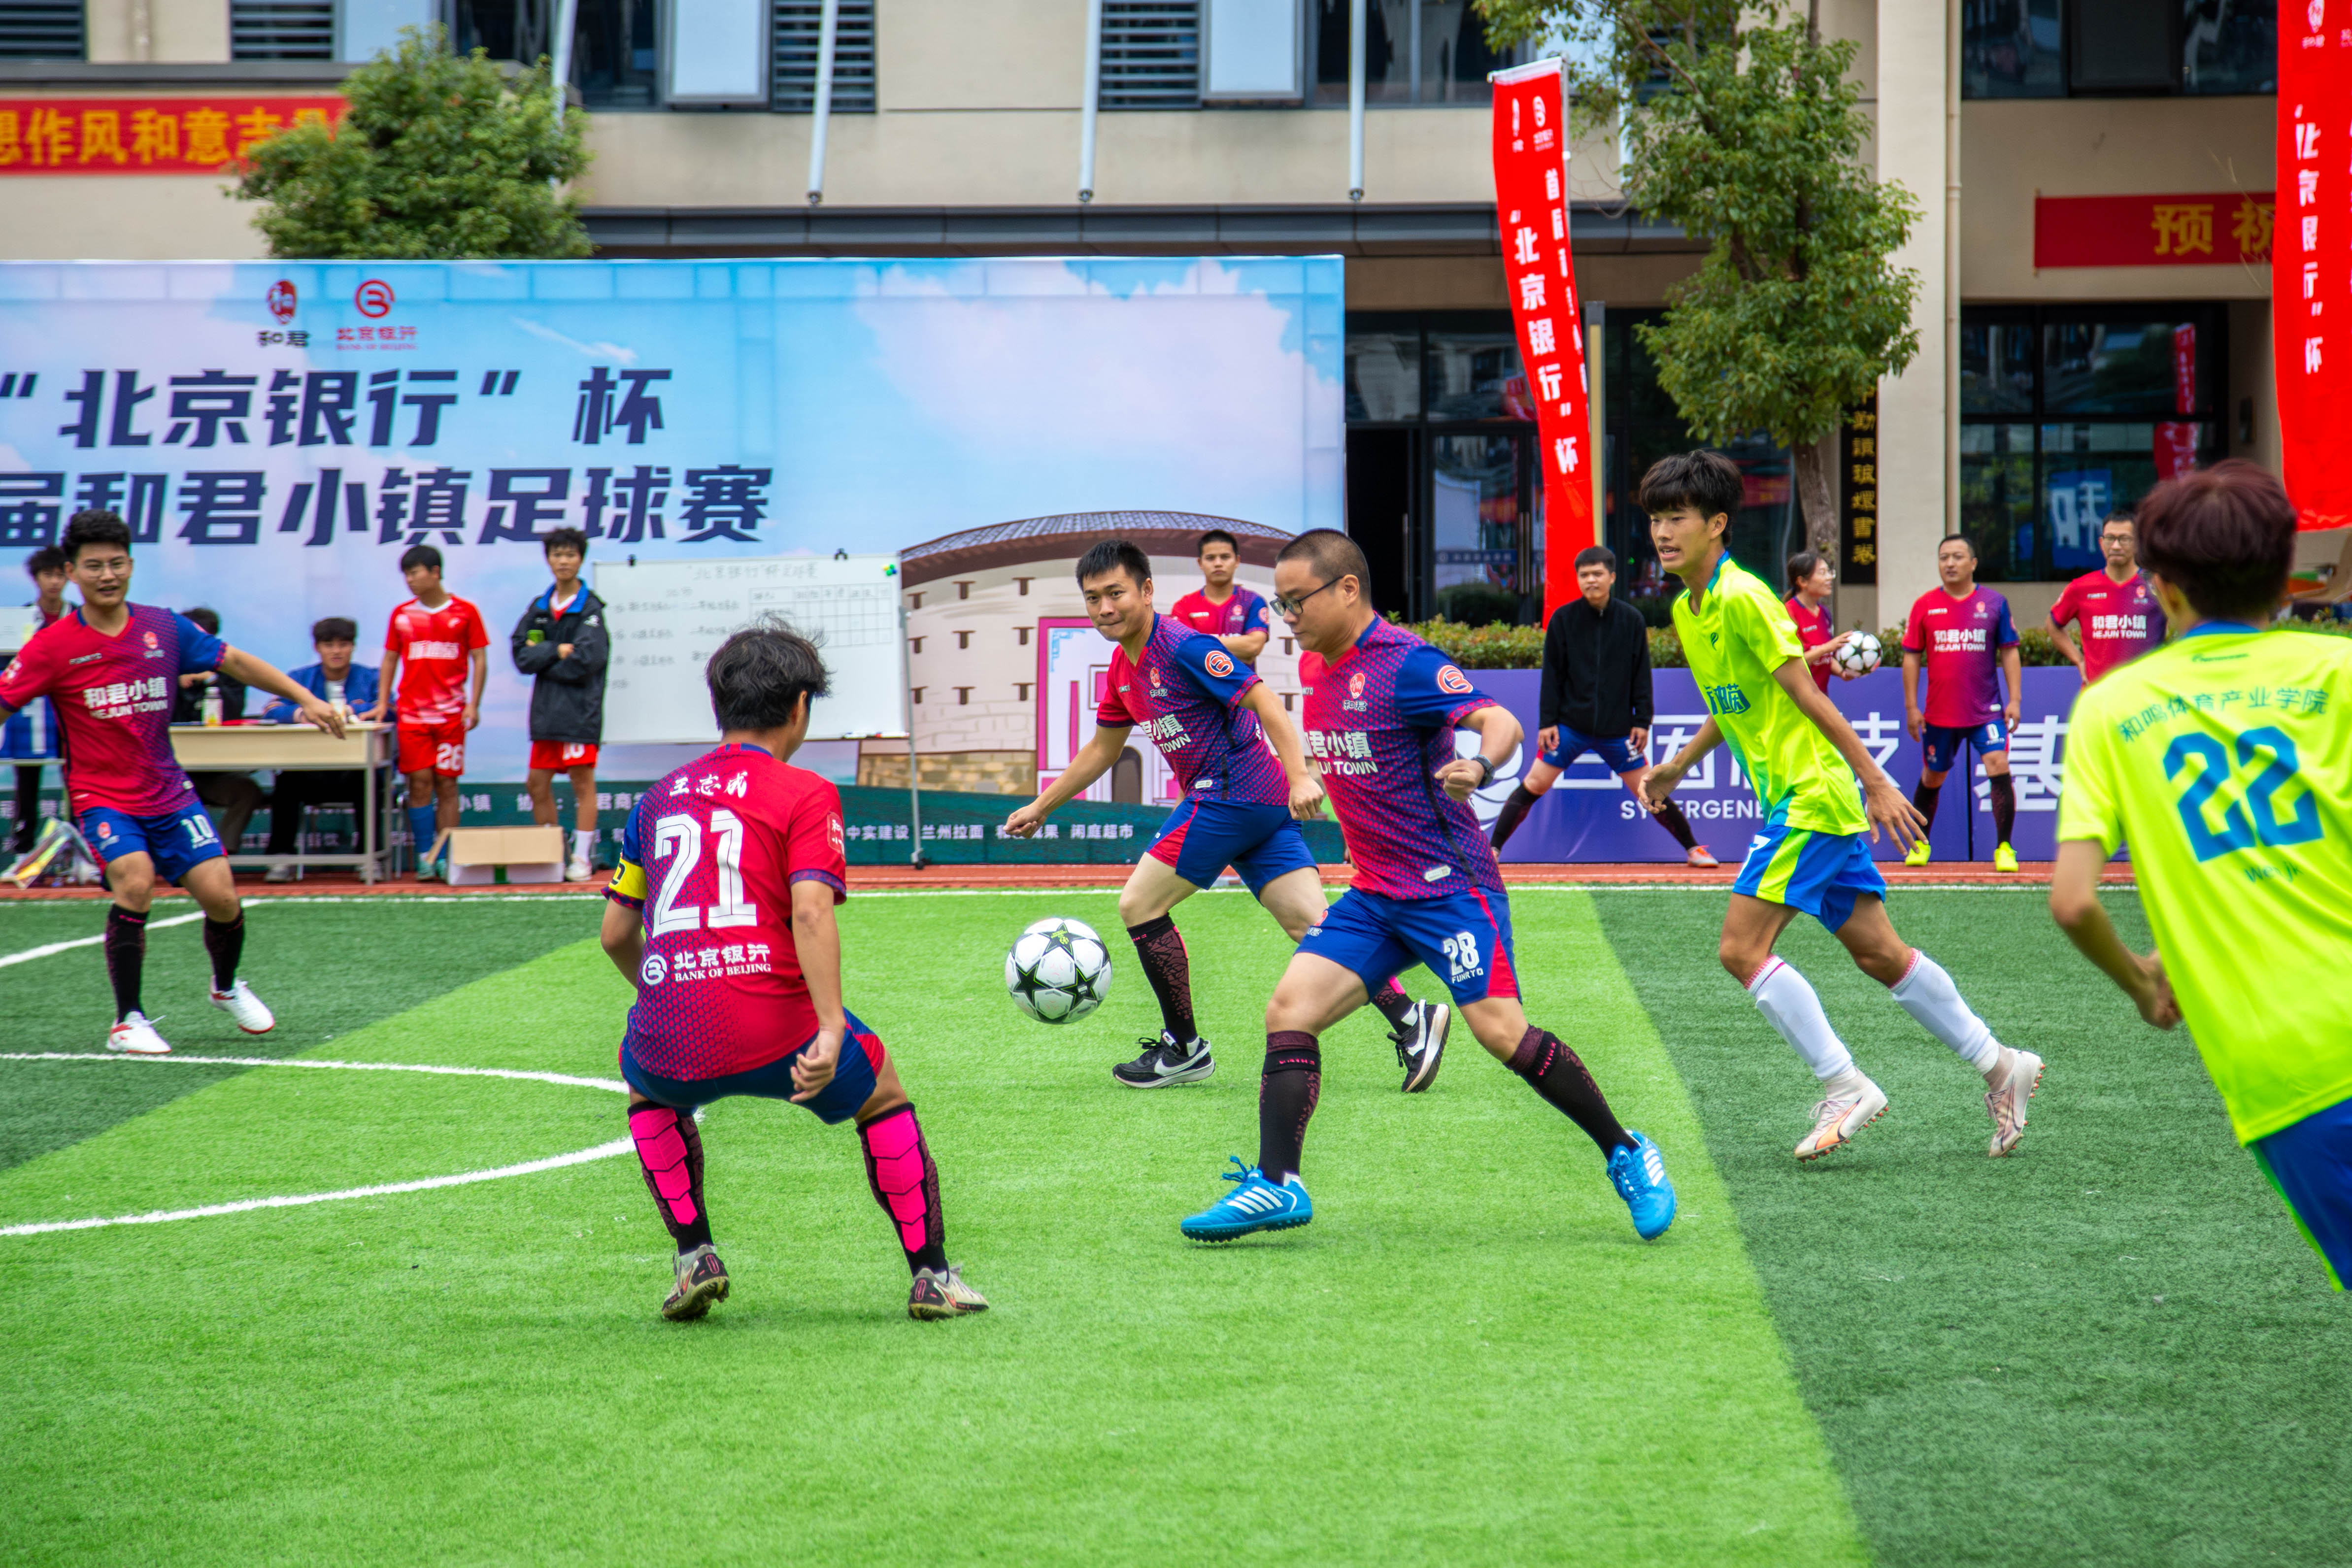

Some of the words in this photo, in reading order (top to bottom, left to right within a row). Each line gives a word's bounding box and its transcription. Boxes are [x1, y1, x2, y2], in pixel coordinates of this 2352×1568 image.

[2092, 614, 2147, 630] 和君小镇
[1934, 629, 1986, 644] 和君小镇
[2120, 630, 2147, 639] TOWN
[1962, 643, 1986, 652] TOWN
[83, 676, 168, 709] 和君小镇
[1344, 700, 1368, 711] 和君
[2118, 687, 2329, 742] 和鸣体育产业学院
[1305, 731, 1373, 760] 君小镇
[1334, 761, 1378, 775] TOWN
[2163, 726, 2324, 862] 22
[180, 814, 215, 843] 10
[846, 825, 909, 840] 中实建设
[921, 825, 984, 839] 兰州拉面
[1070, 824, 1134, 839] 闲庭超市
[652, 808, 757, 939] 21
[673, 944, 771, 969] 北京银行
[1443, 932, 1479, 976] 28
[674, 970, 706, 982] BANK
[708, 968, 723, 978] OF
[726, 963, 771, 976] BEIJING
[1451, 968, 1483, 983] FUNRYO
